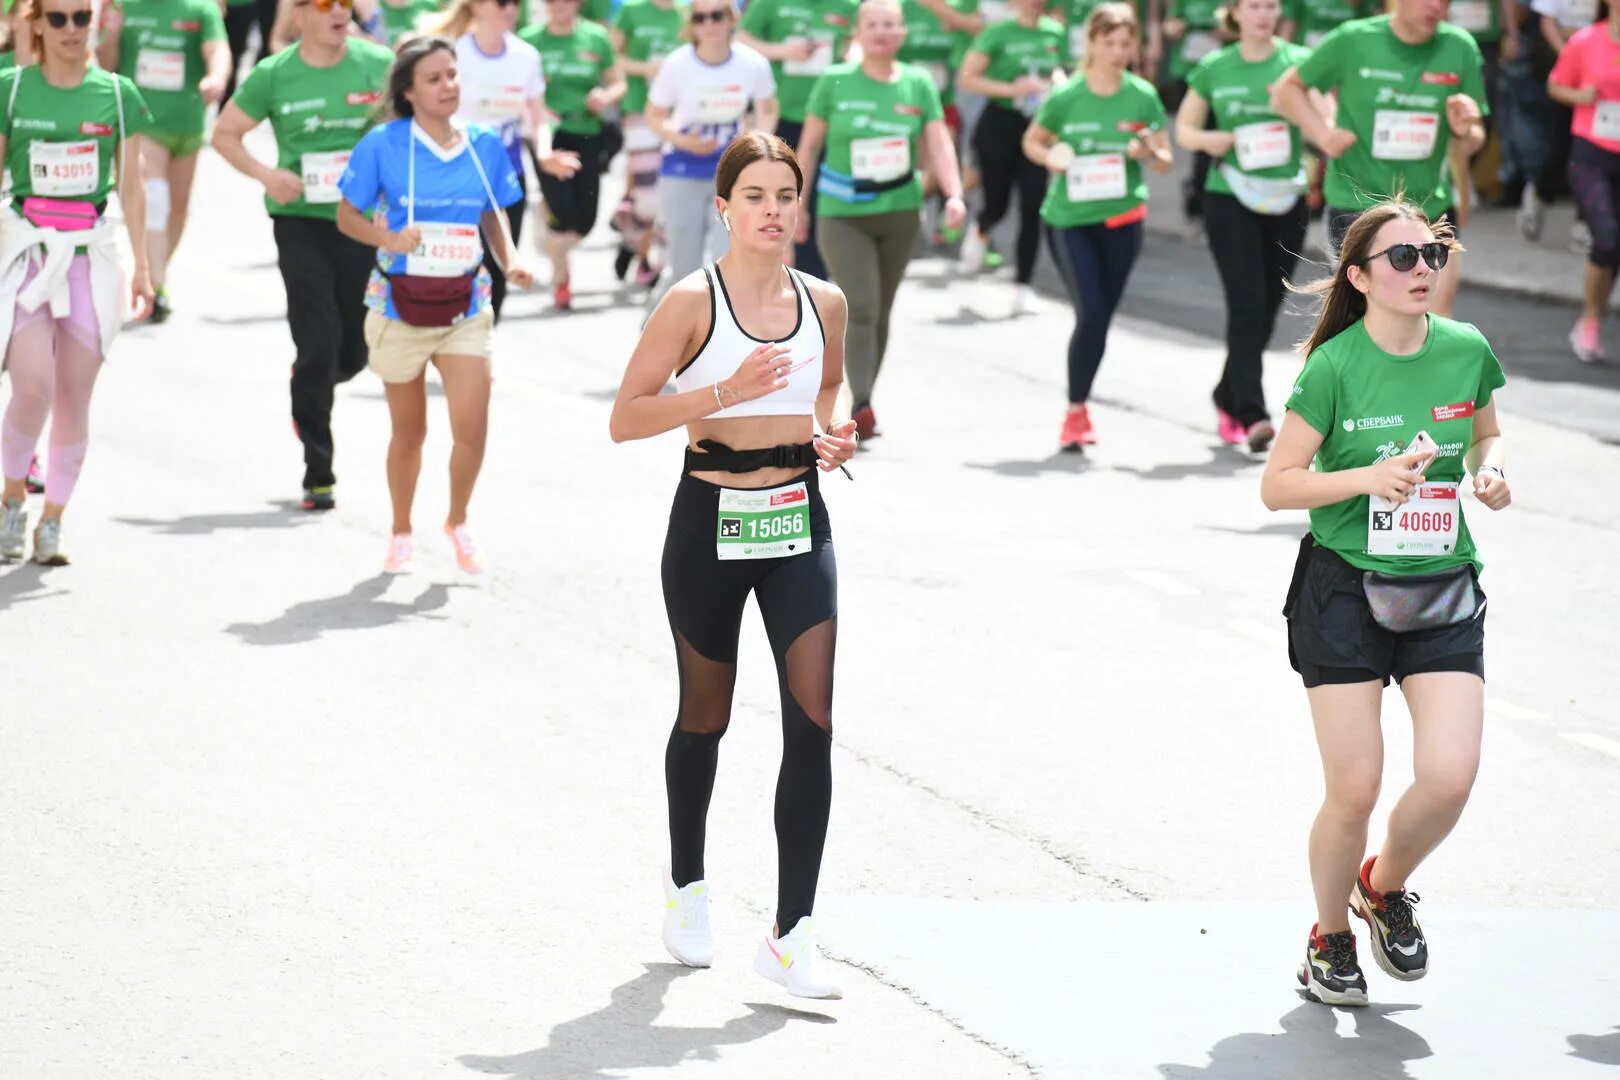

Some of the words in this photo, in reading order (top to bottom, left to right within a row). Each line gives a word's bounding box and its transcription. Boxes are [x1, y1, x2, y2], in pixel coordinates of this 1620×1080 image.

[52, 161, 94, 177] 43015
[1356, 414, 1404, 428] СБЕРБАНК
[747, 512, 804, 539] 15056
[1399, 511, 1452, 532] 40609
